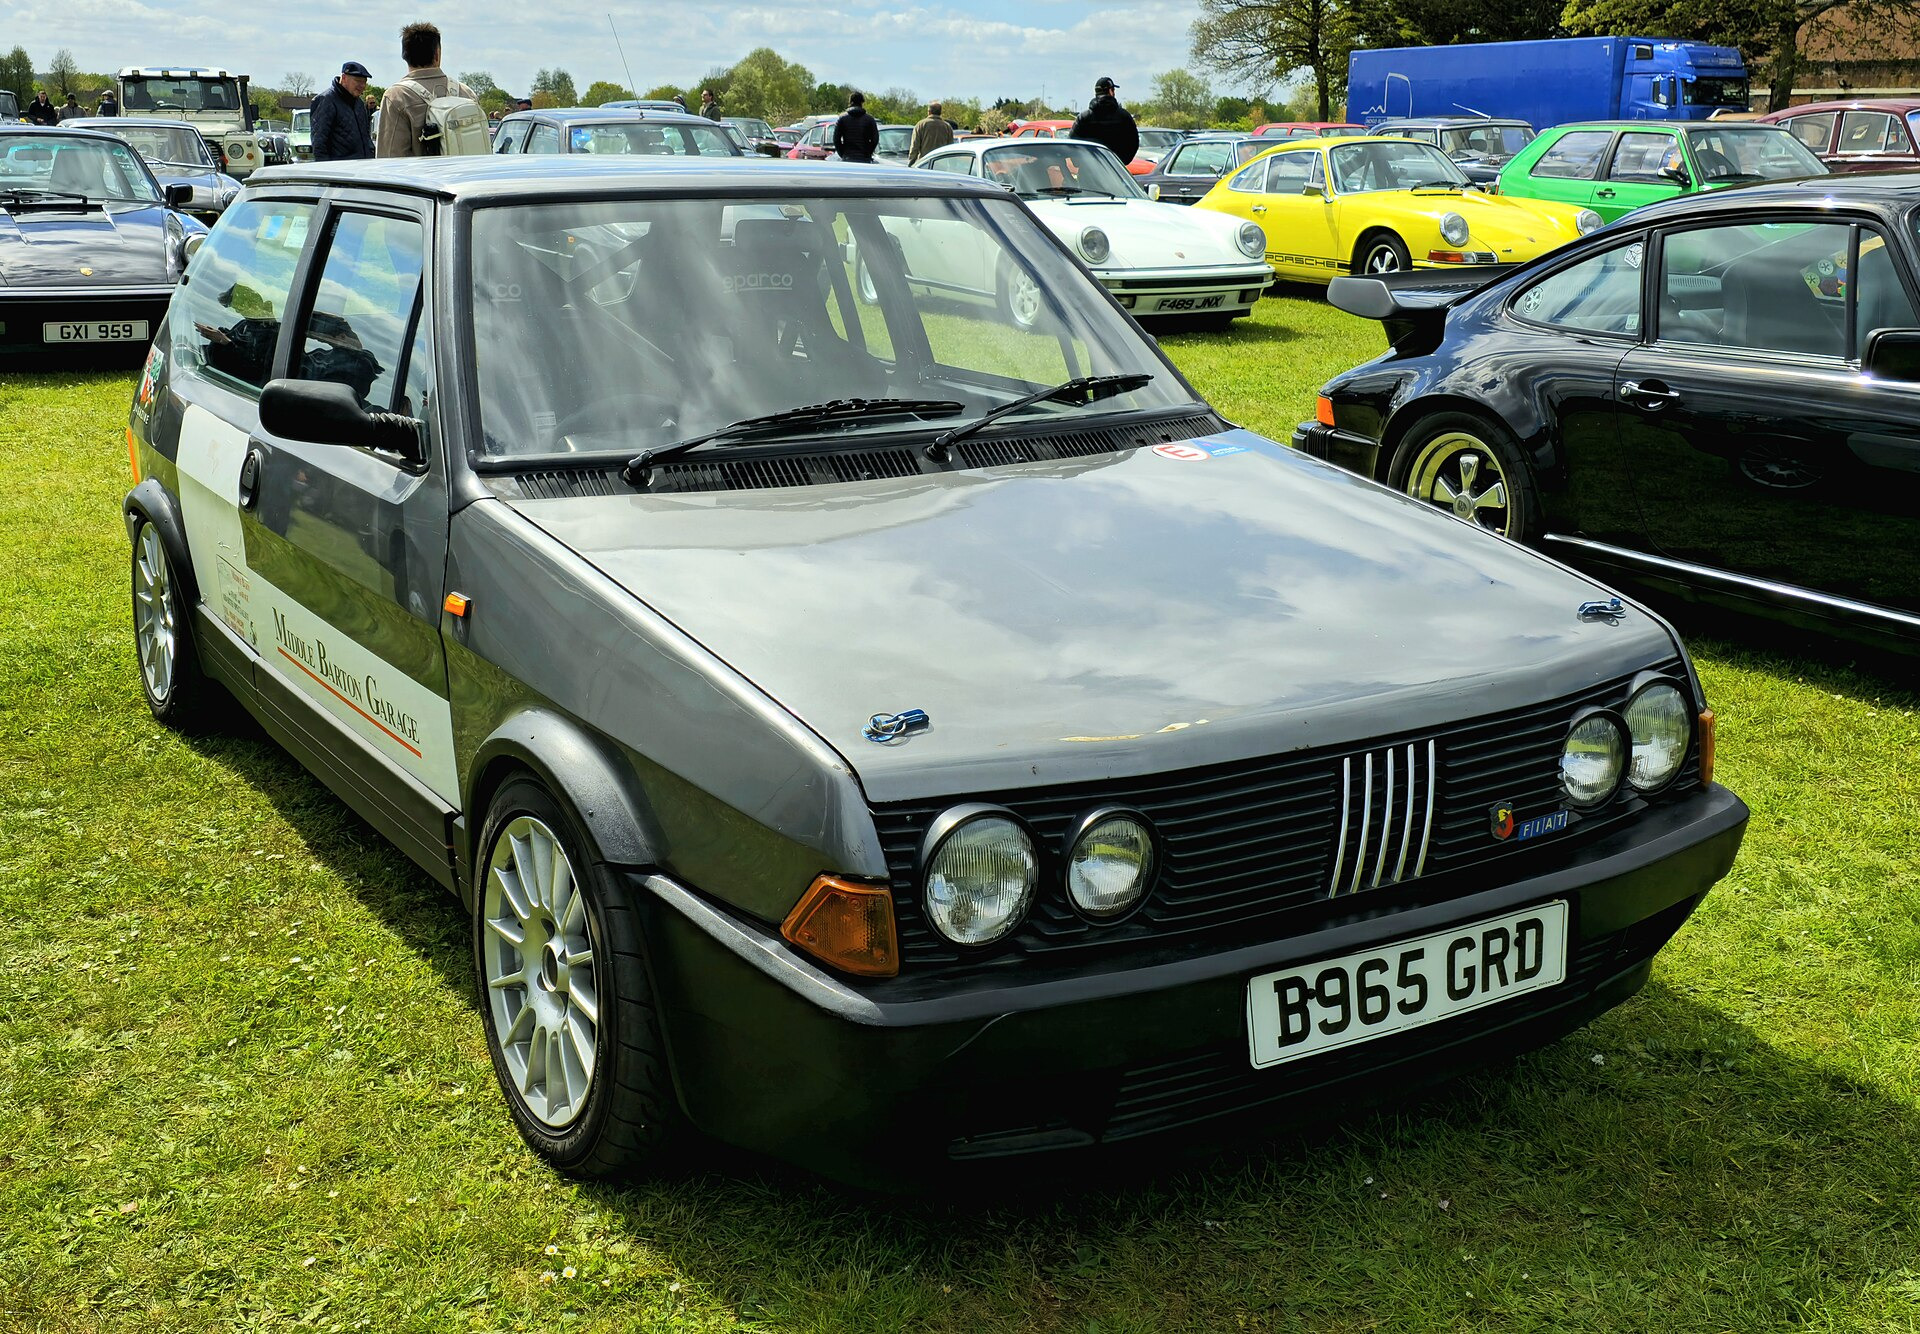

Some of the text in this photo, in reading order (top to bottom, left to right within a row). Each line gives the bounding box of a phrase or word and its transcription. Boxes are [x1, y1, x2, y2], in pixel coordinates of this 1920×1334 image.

[1265, 254, 1336, 269] PORSCHE
[1158, 296, 1223, 311] F489 JNX
[60, 324, 133, 339] GXI 959
[1523, 813, 1565, 837] FIAT
[1273, 917, 1544, 1049] B965 GRD
